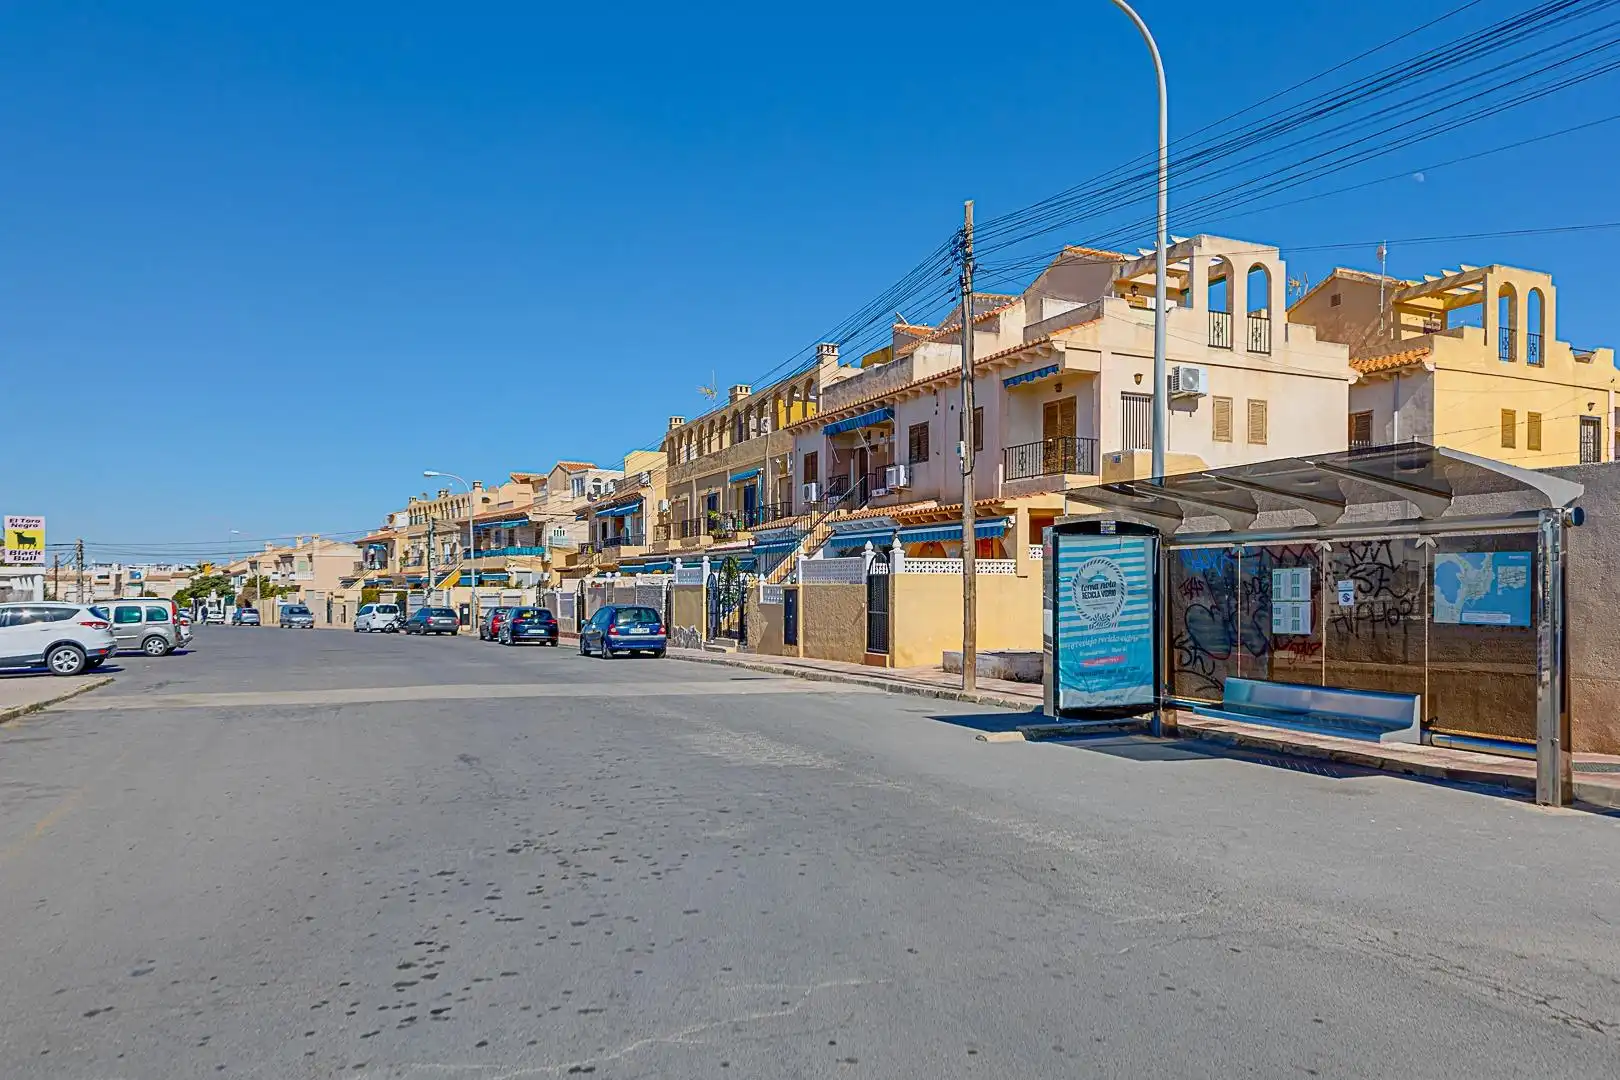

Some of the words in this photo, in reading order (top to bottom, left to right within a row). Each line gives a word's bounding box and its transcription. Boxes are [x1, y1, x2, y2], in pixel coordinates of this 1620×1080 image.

[1100, 580, 1117, 590] nota
[1081, 591, 1101, 600] RECICLA
[1101, 589, 1117, 598] VIDRIO
